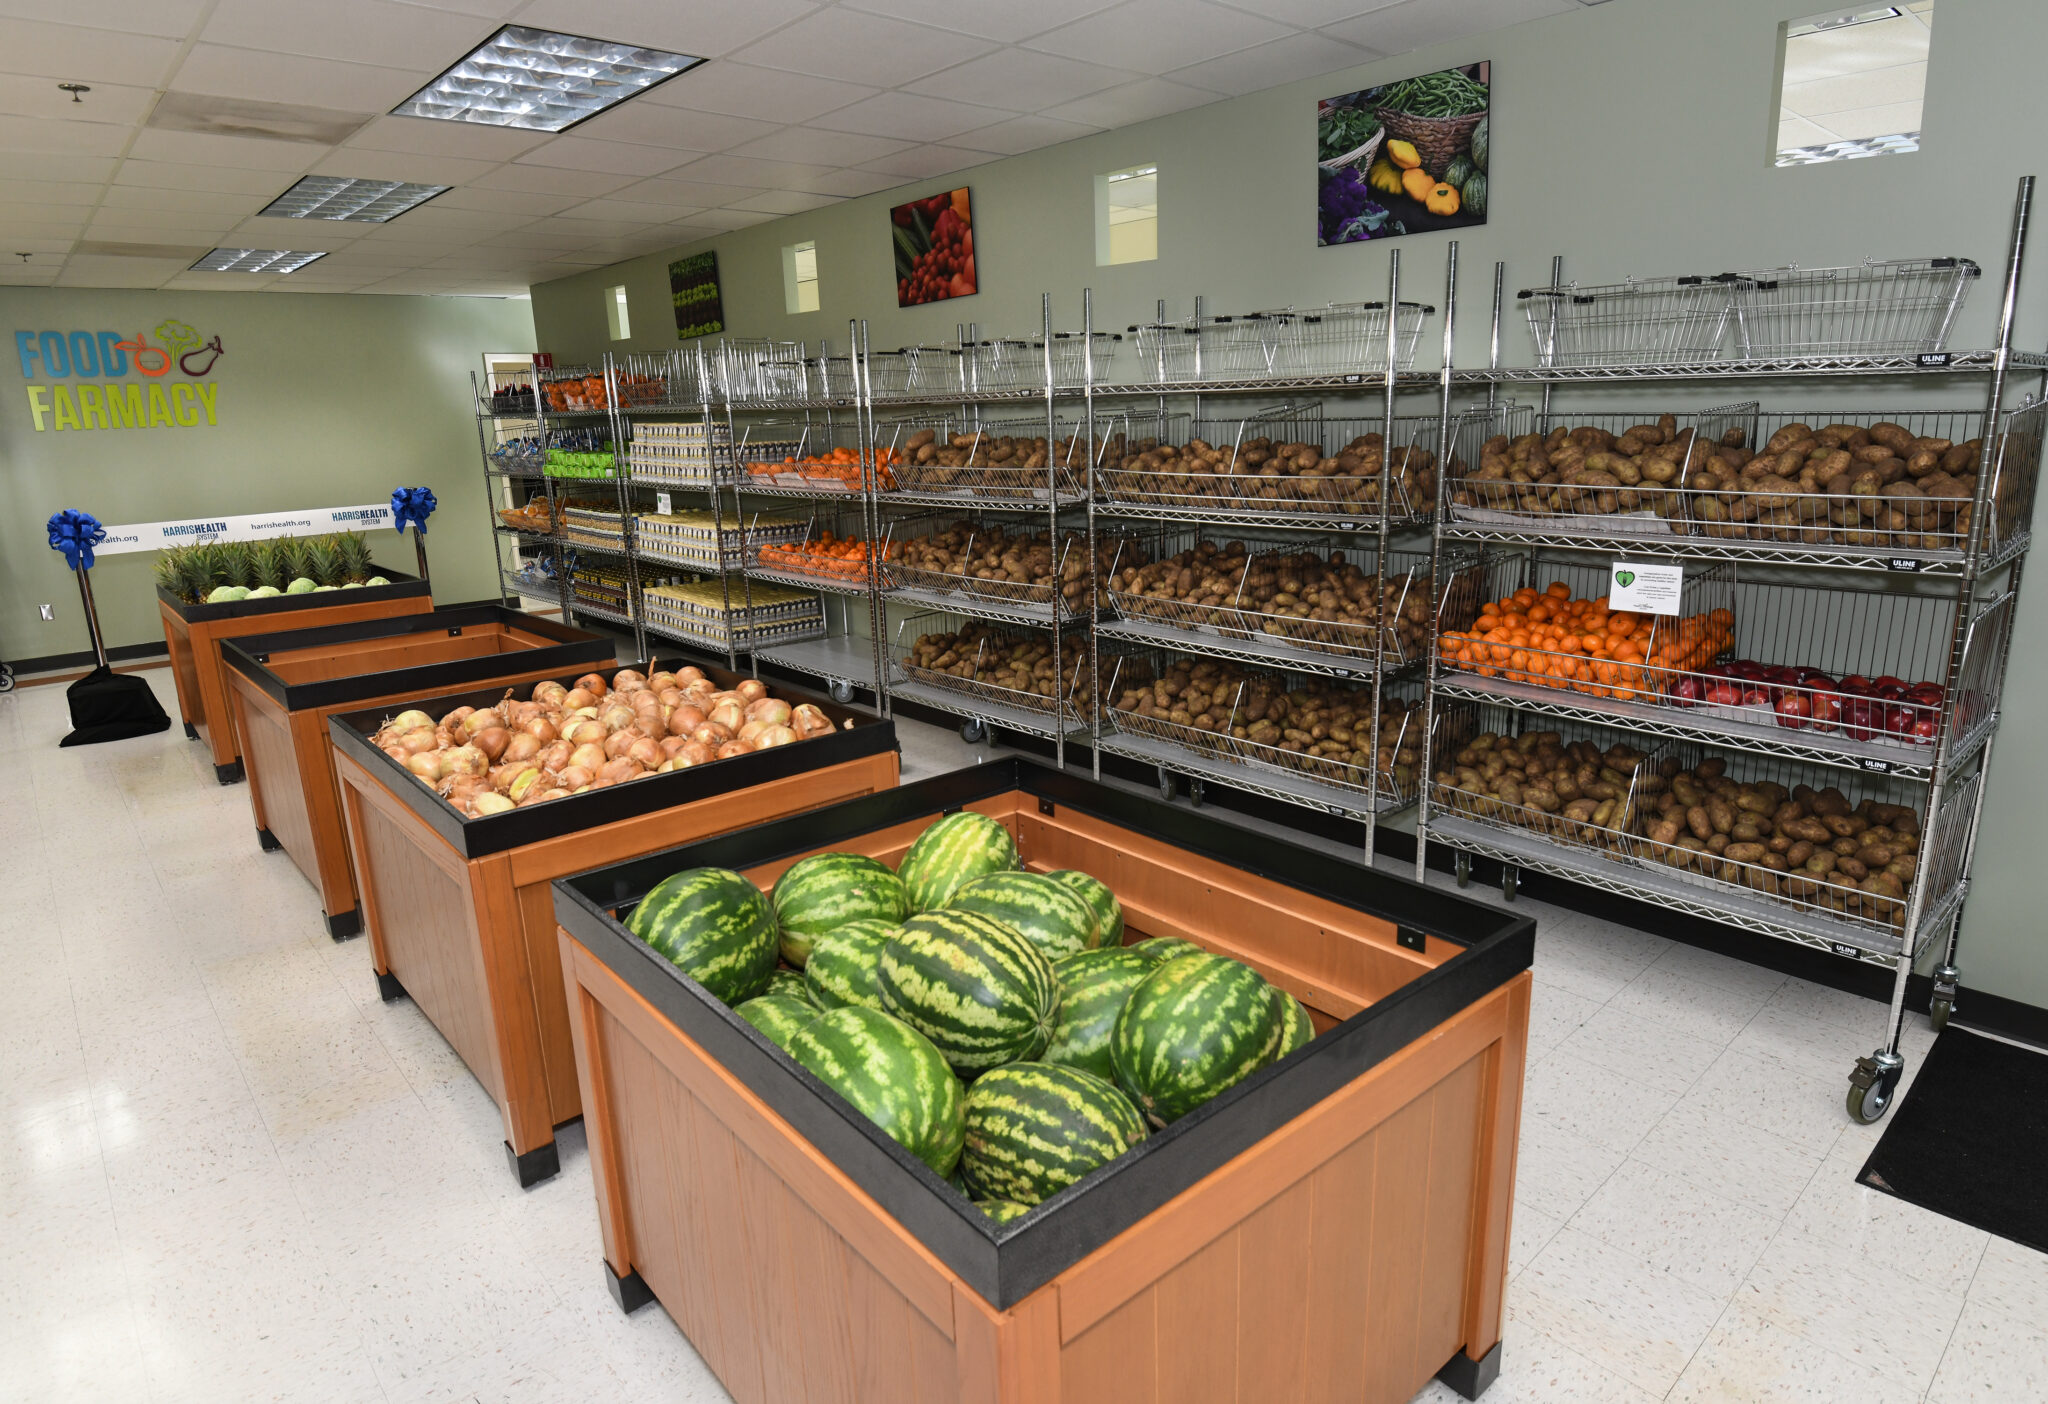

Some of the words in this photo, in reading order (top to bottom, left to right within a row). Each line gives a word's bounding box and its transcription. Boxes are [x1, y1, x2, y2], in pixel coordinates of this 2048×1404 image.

[15, 331, 128, 378] FOOD
[27, 383, 217, 432] FARMACY
[251, 519, 311, 530] harrishealth.org
[361, 518, 381, 526] SYSTEM
[196, 532, 219, 541] SYSTEM
[1893, 560, 1916, 568] ULINE
[1865, 760, 1887, 769] ULINE
[1836, 944, 1857, 955] ULINE
